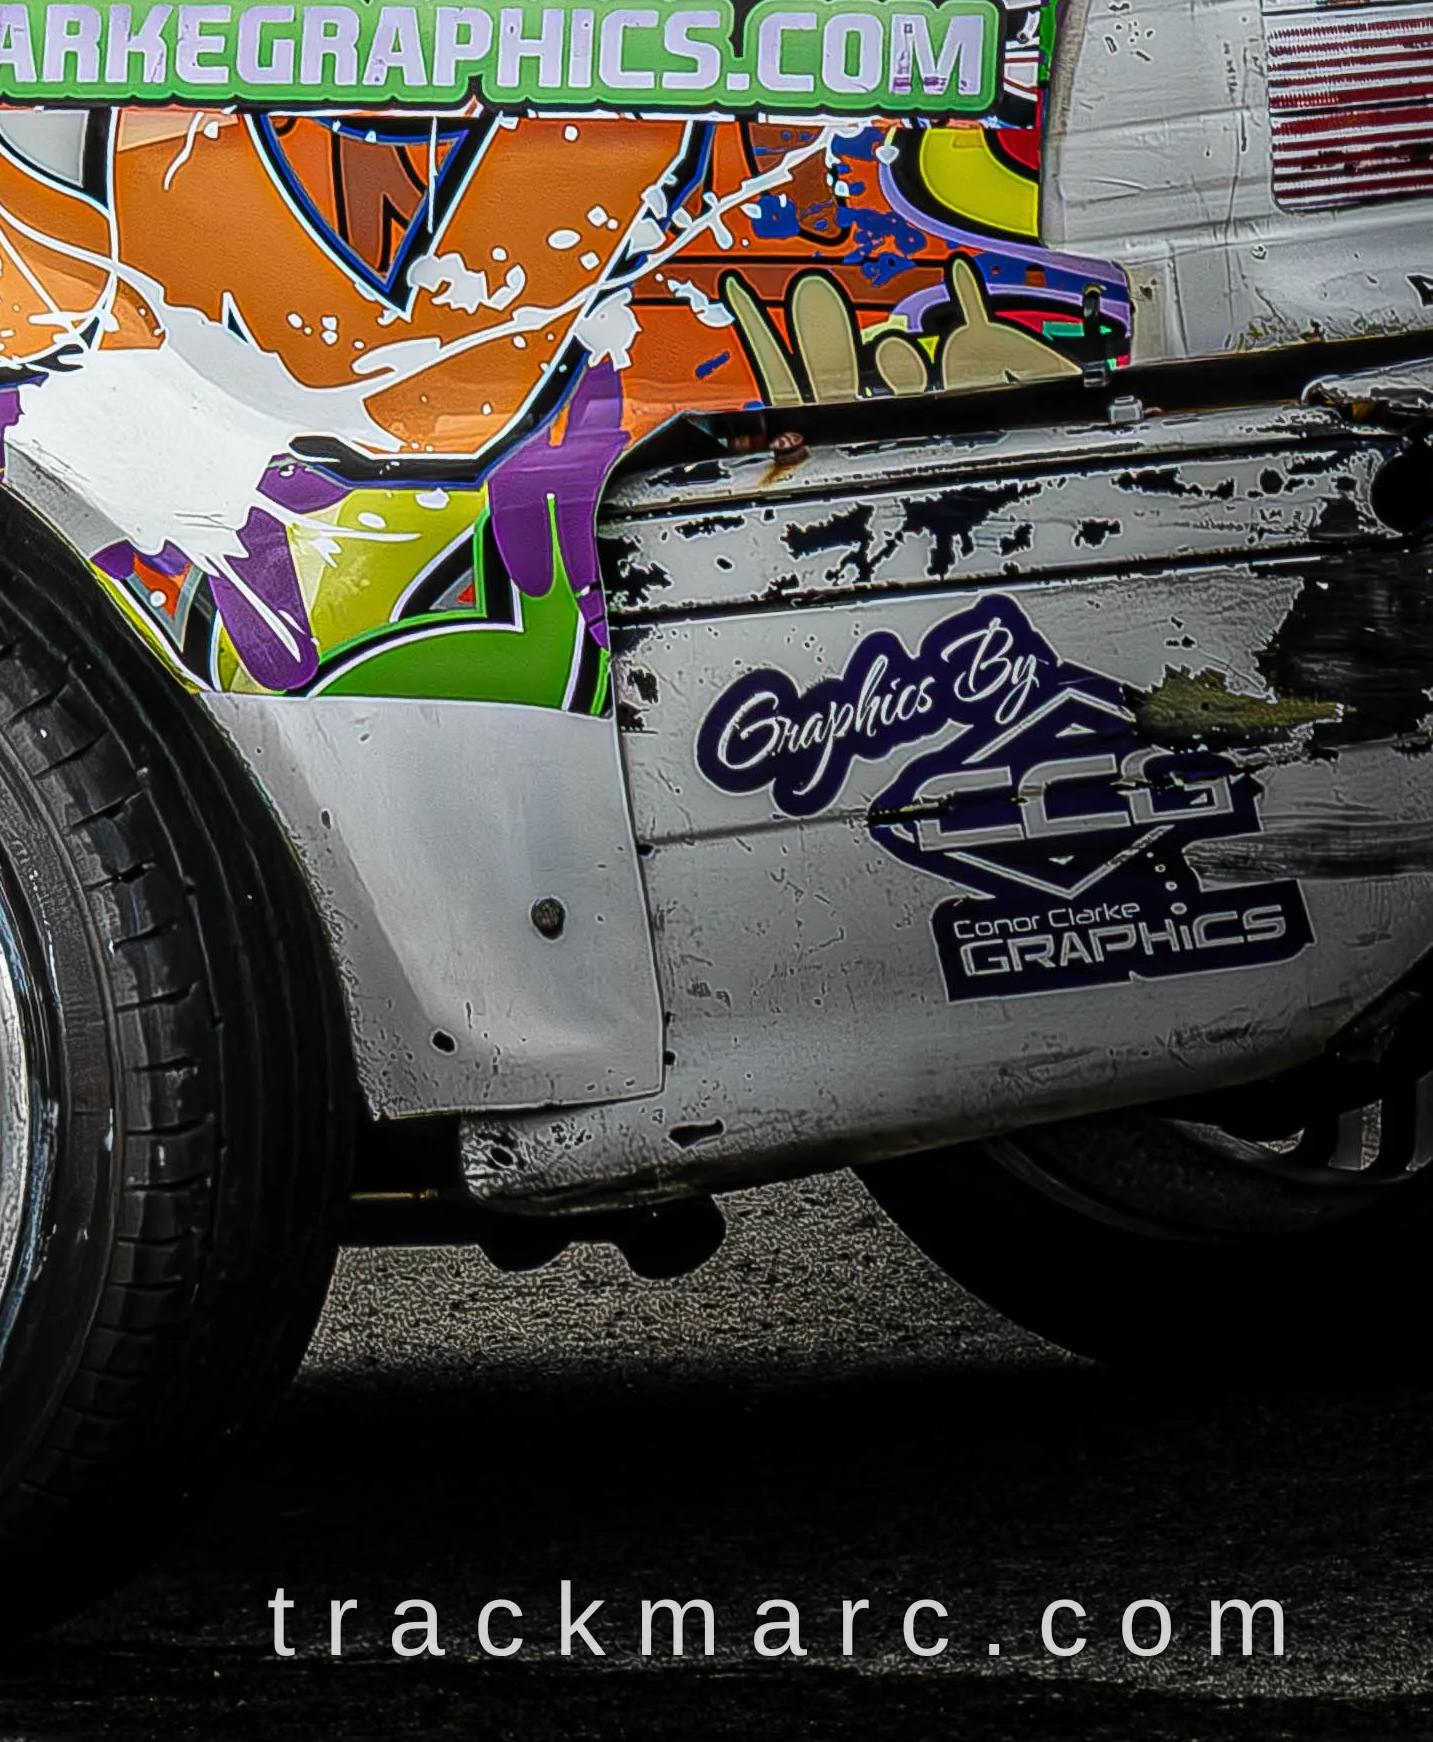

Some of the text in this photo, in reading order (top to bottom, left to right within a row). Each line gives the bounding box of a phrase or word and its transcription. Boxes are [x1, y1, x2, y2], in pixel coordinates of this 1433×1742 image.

[718, 618, 1041, 796] Graphics By
[953, 902, 1141, 939] Conor Clarke
